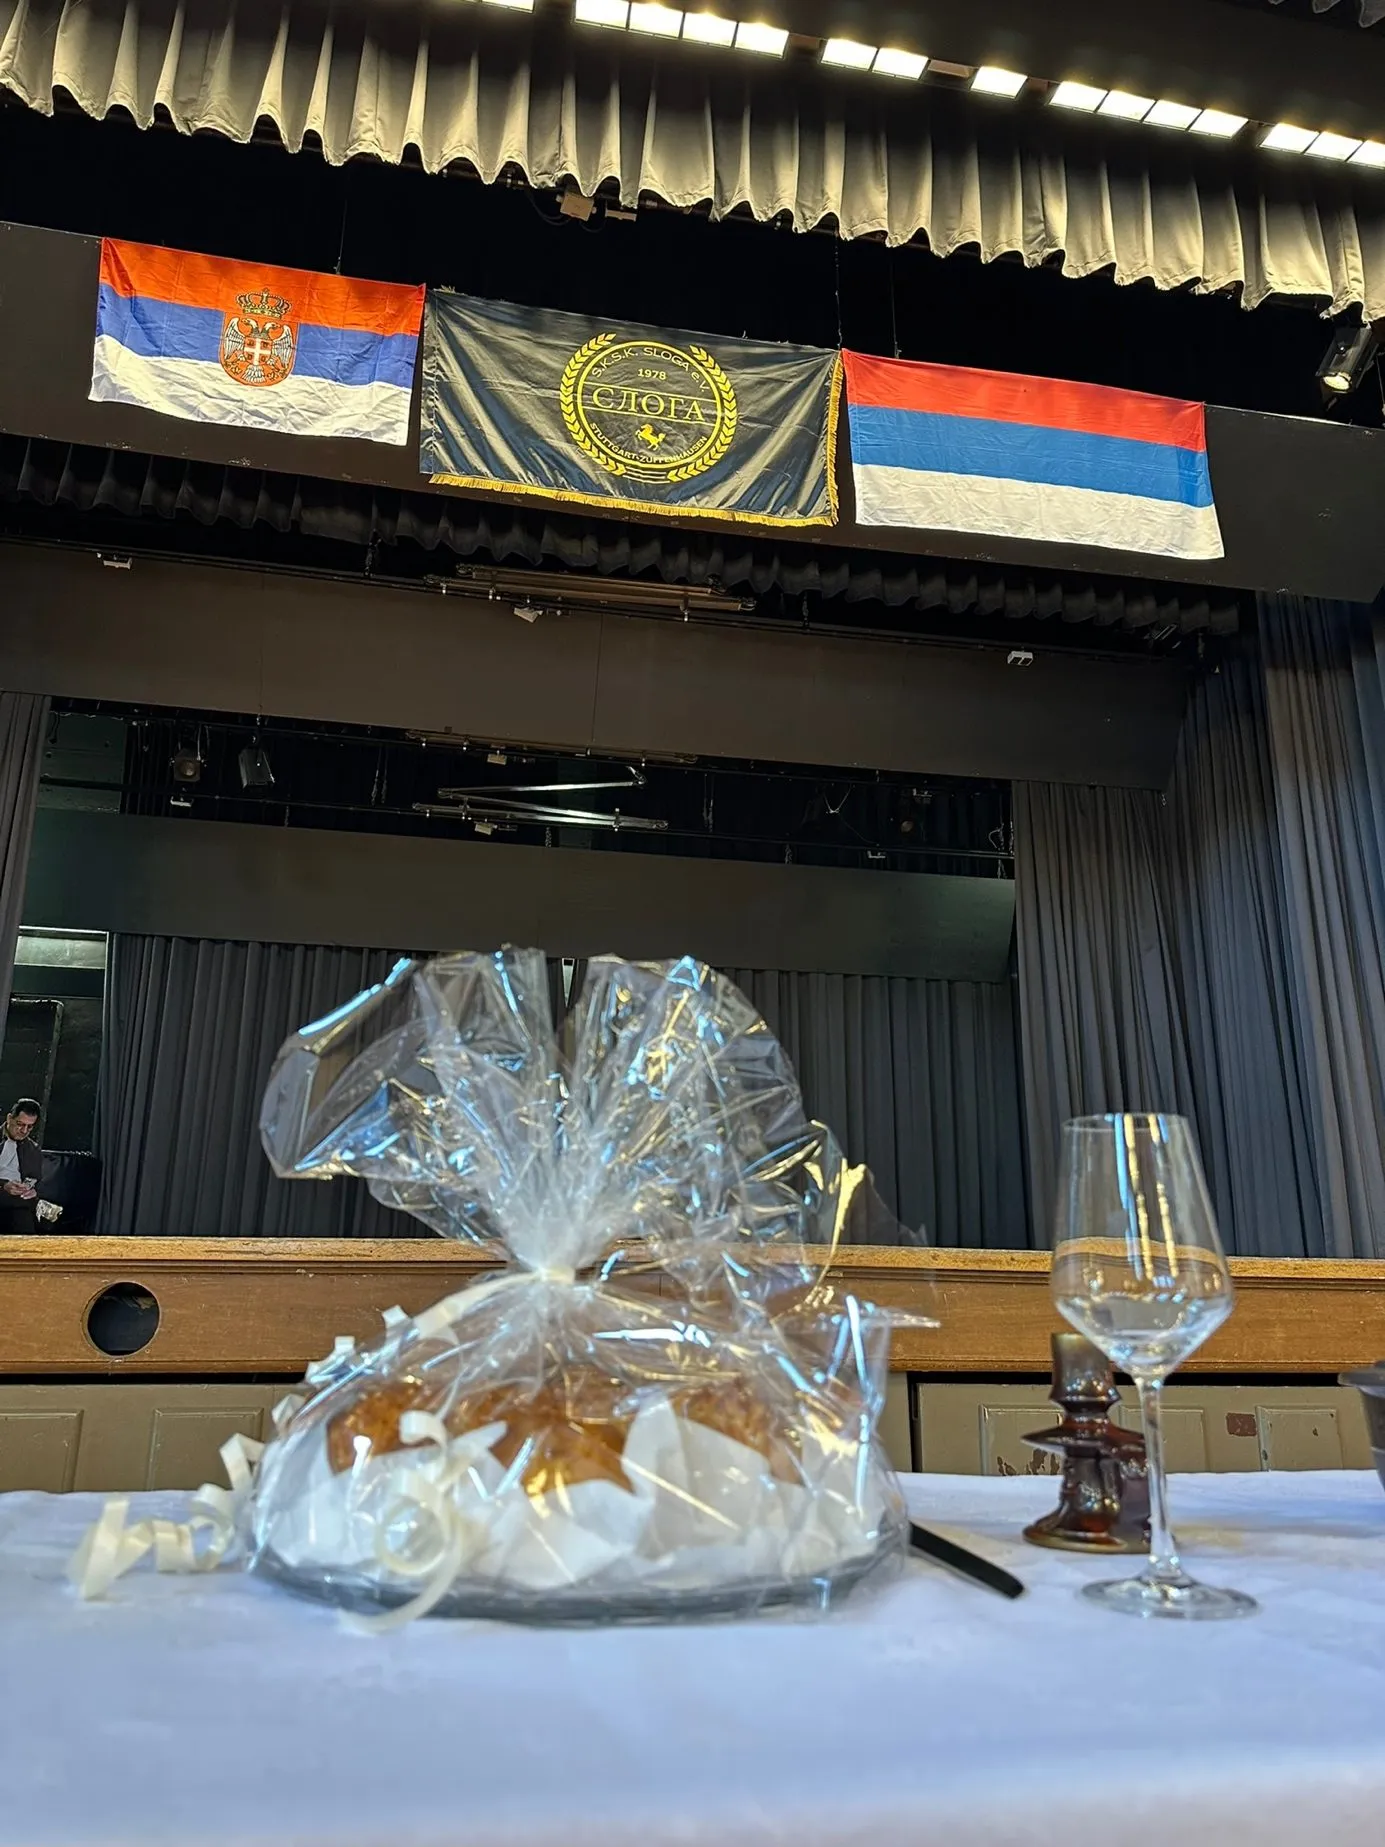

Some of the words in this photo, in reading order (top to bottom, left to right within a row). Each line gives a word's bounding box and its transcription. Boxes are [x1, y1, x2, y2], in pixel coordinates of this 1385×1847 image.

[591, 347, 639, 378] S.K.S.K.
[643, 347, 690, 372] SLOGA
[691, 371, 710, 393] e.V.
[637, 368, 667, 381] 1978
[592, 387, 705, 421] СЛОГА
